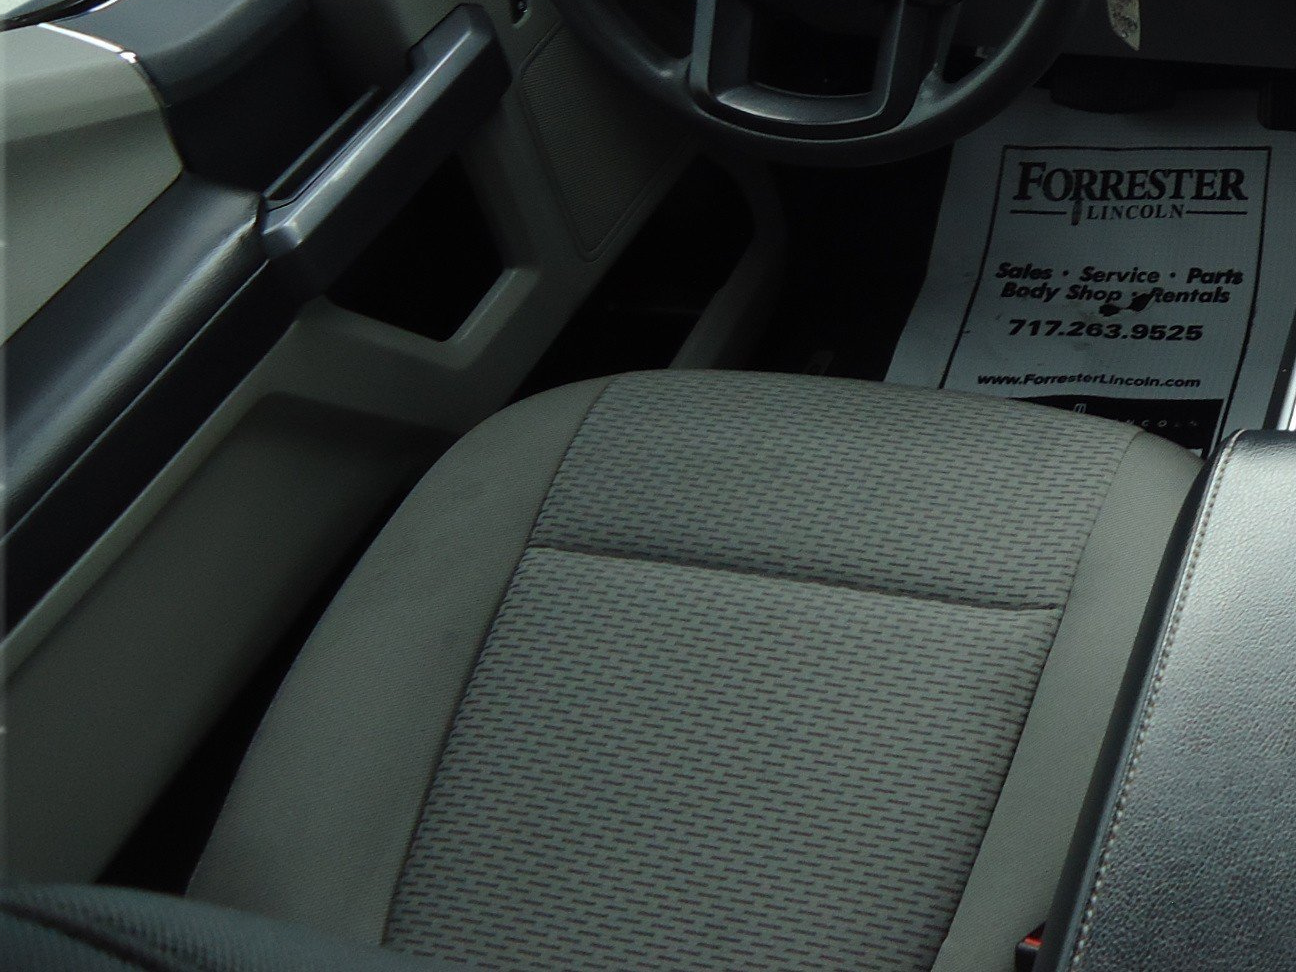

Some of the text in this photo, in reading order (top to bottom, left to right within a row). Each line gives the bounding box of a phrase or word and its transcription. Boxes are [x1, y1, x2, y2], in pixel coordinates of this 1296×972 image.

[1011, 161, 1249, 202] FORRESTER
[1086, 204, 1185, 220] LINCOLN
[995, 262, 1244, 286] Sales Service Parts
[1000, 281, 1231, 304] Body Shop Rentals
[1008, 318, 1204, 342] 717.263.9525
[976, 372, 1202, 389] www.ForresterLincoln.com
